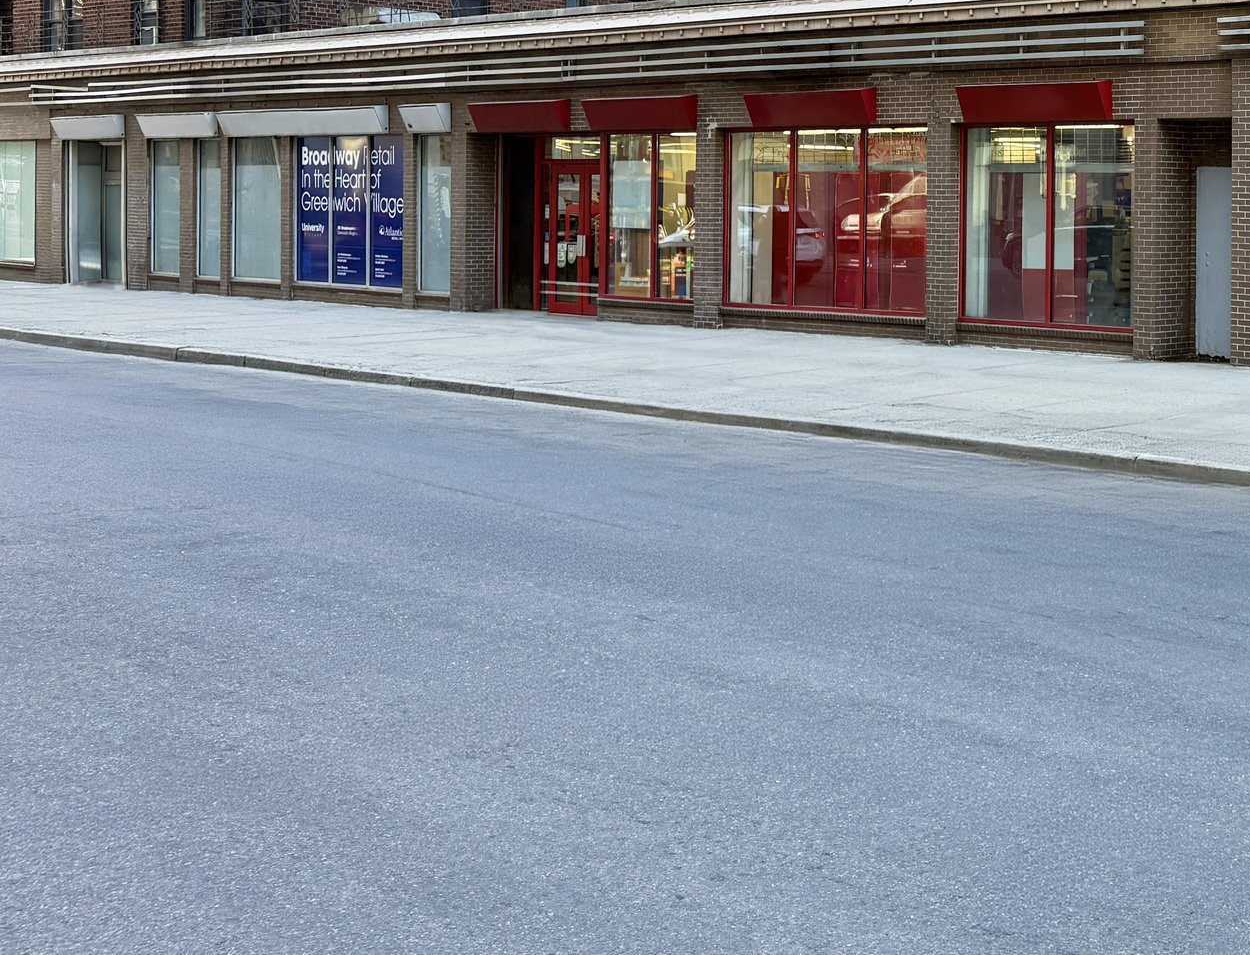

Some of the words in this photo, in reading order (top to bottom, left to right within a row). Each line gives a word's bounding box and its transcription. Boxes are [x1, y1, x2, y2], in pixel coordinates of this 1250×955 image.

[302, 169, 311, 188] In
[314, 169, 330, 188] the
[335, 169, 366, 189] Heart
[370, 169, 381, 189] of
[302, 222, 325, 234] University
